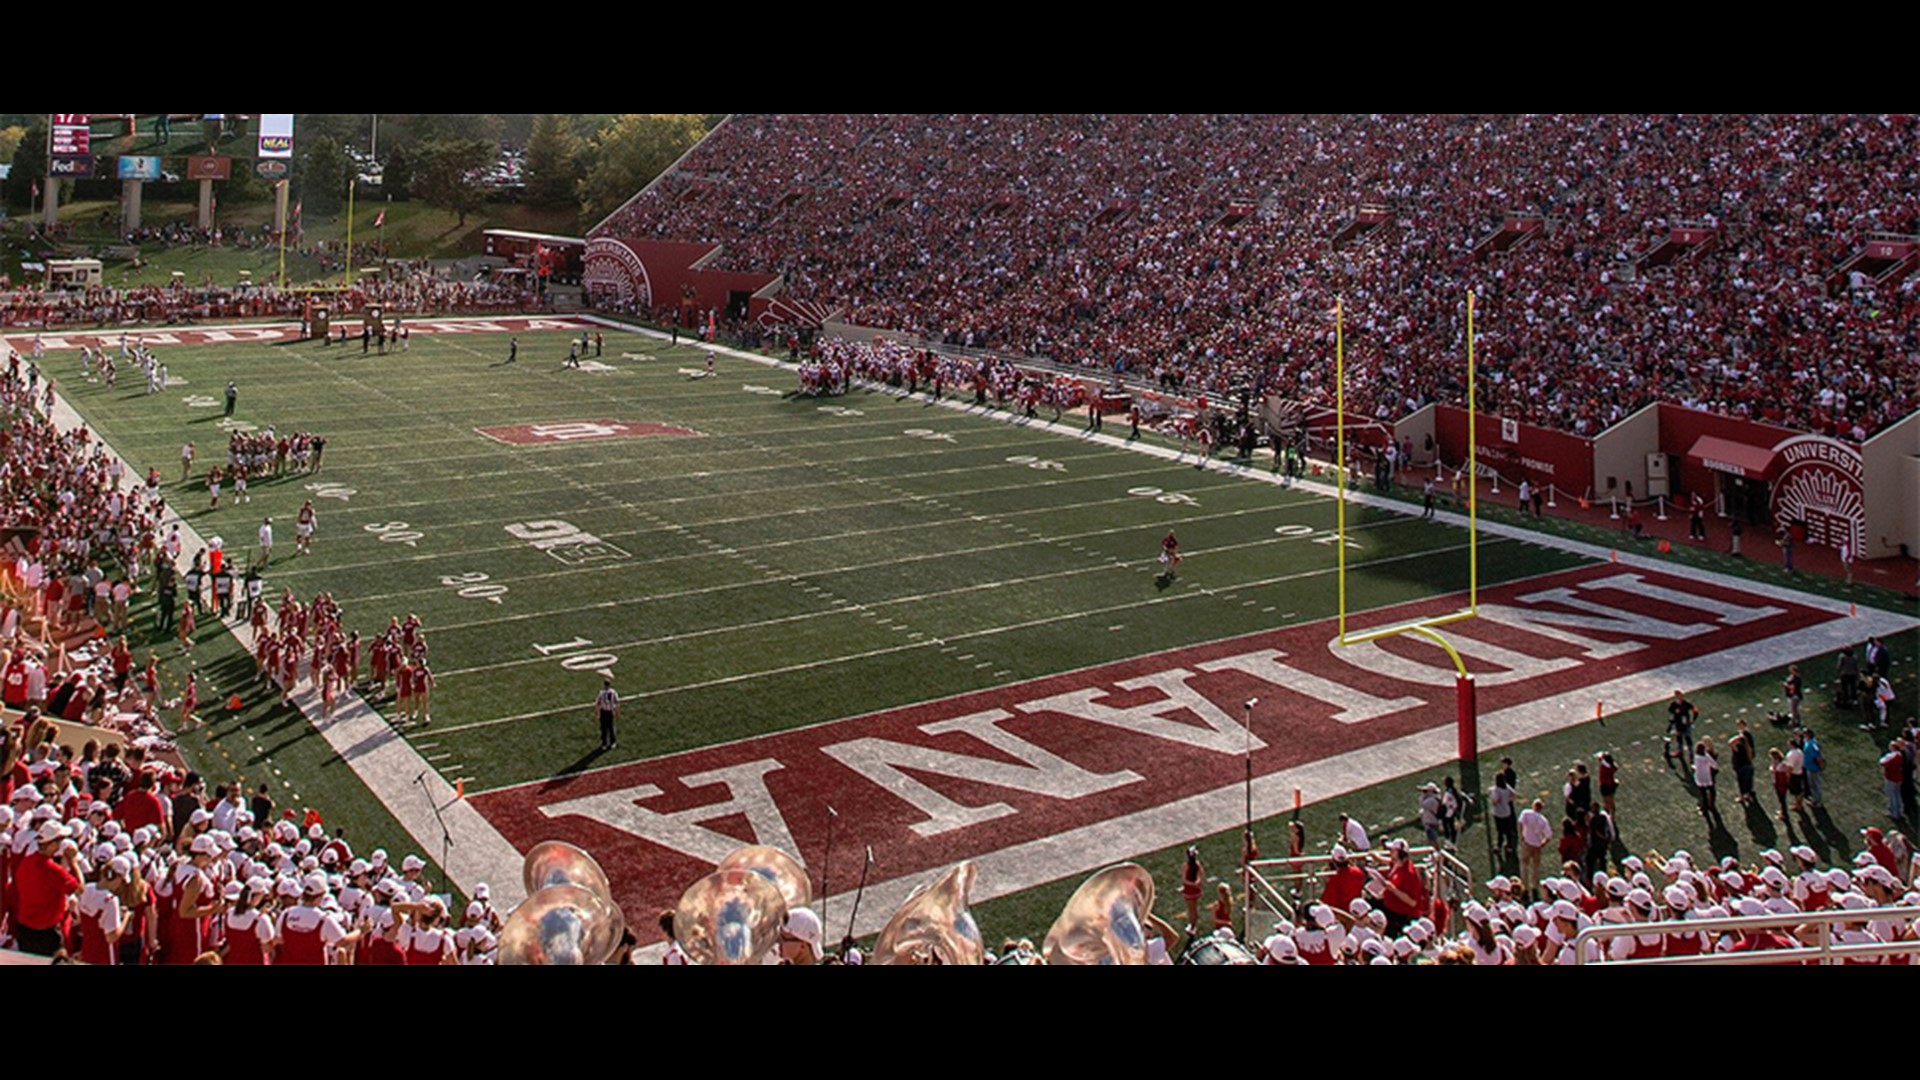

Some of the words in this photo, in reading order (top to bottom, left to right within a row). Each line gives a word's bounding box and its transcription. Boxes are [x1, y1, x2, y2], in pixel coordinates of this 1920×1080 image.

[52, 160, 88, 172] FedEx
[1881, 246, 1894, 256] 10
[1783, 442, 1864, 481] UNIVERSIT
[363, 520, 425, 543] 30
[440, 571, 510, 599] 20
[532, 636, 619, 672] 10
[538, 573, 1788, 870] INDIANA
